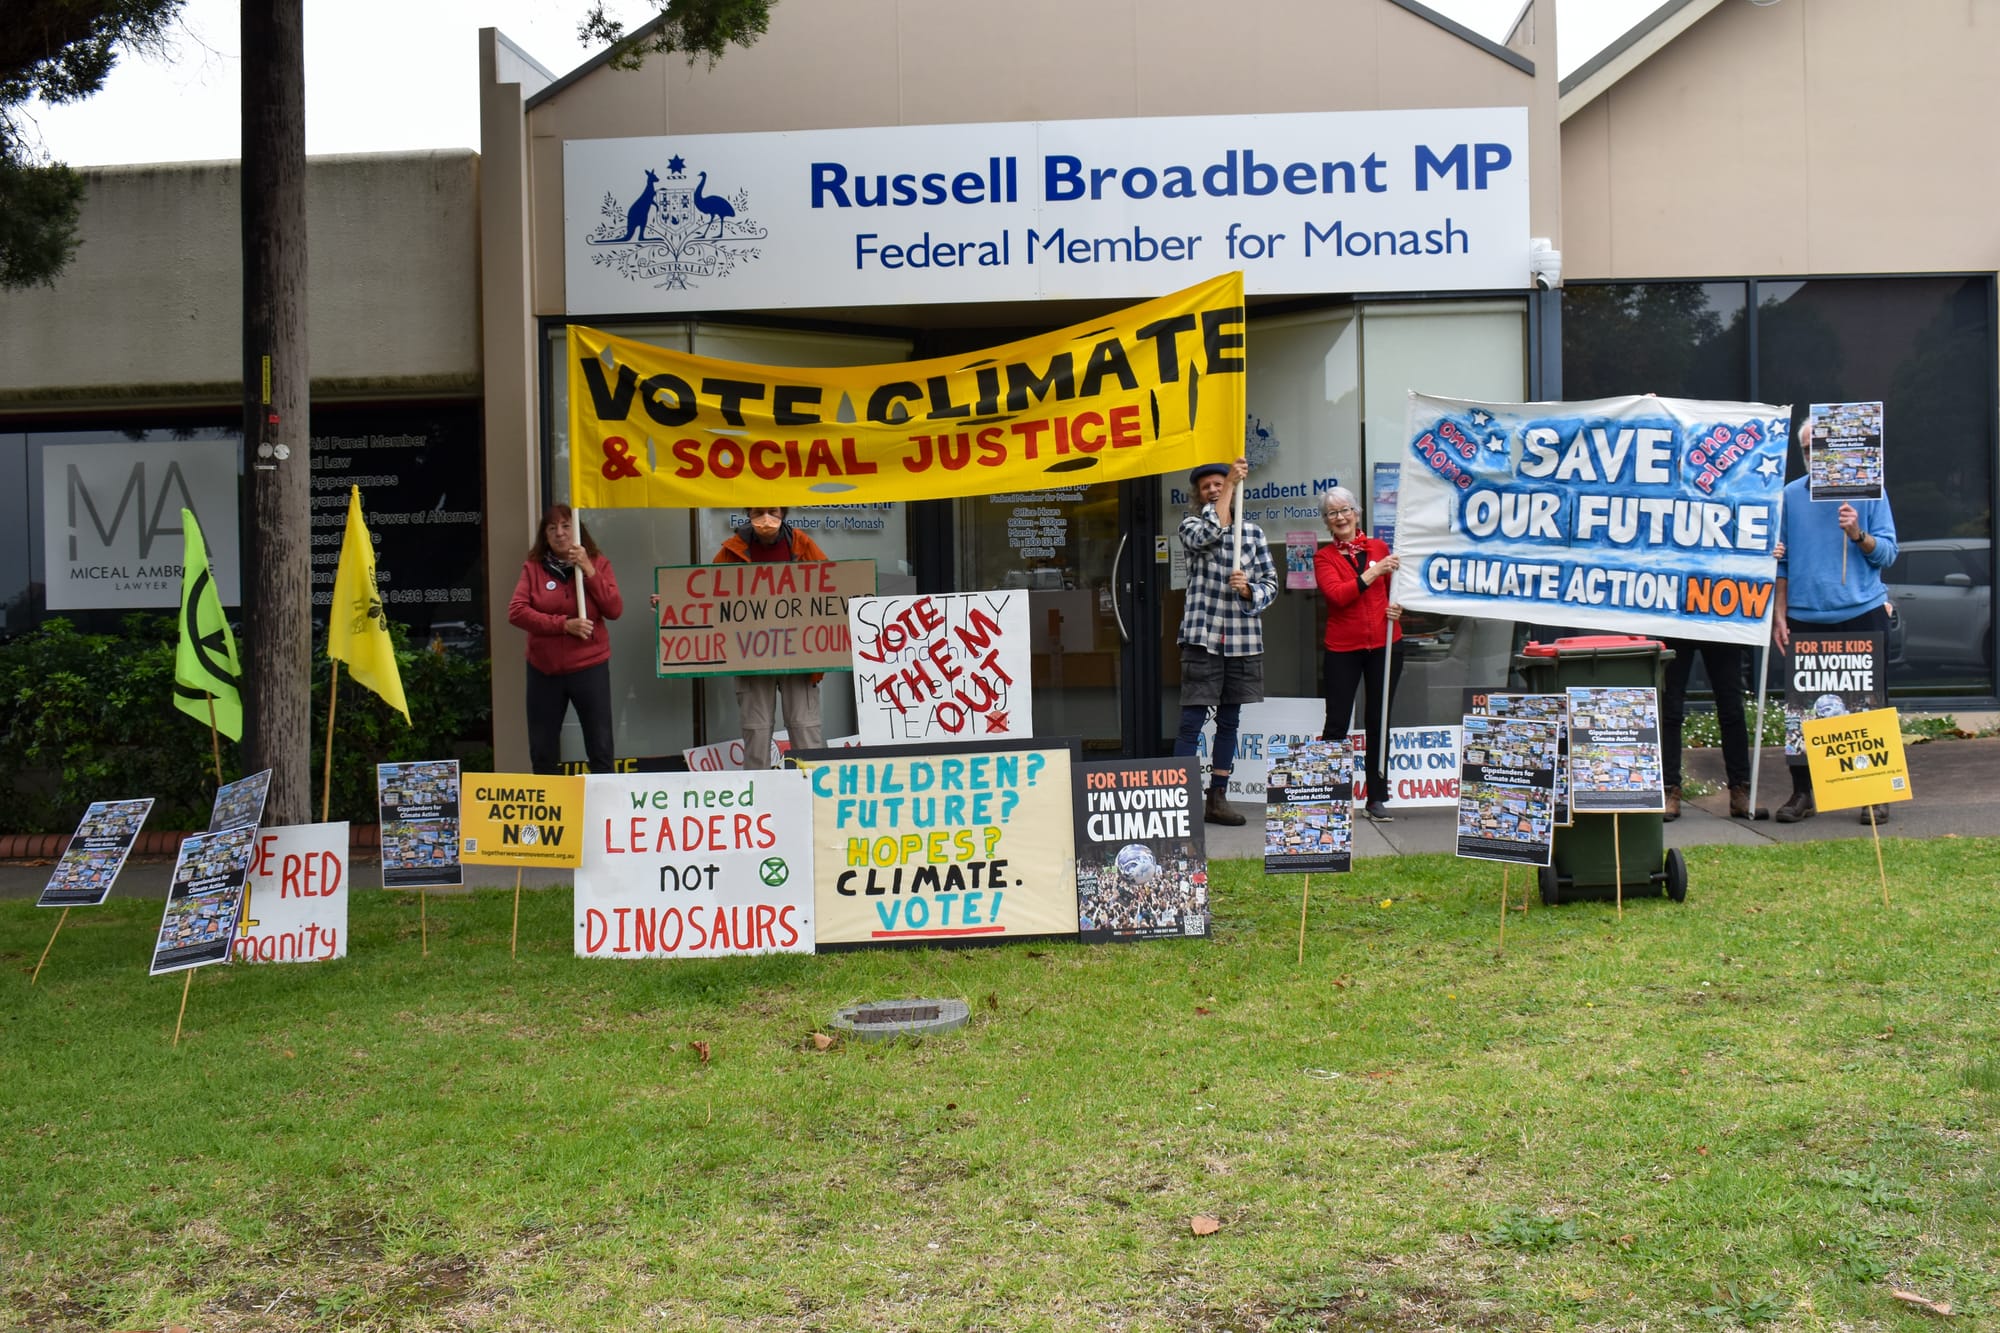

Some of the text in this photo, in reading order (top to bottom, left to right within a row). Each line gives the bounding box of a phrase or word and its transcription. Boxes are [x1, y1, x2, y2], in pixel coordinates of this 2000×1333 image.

[810, 143, 1512, 209] Russell Broadbent MP
[855, 217, 1469, 270] Federal Member for Monash
[645, 262, 709, 276] AUSTRALIA
[580, 306, 1246, 427] VOTE CLIMATE
[331, 435, 368, 449] Panel
[370, 434, 427, 448] Member
[602, 404, 1144, 482] & SOCIAL JUSTICE
[1440, 422, 1477, 459] one
[1519, 423, 1673, 483] SAVE
[1689, 425, 1731, 465] one
[324, 456, 352, 469] Law
[1416, 433, 1473, 489] home
[1243, 482, 1307, 501] oadbent
[370, 510, 482, 525] Power of Attorney
[826, 514, 841, 528] for
[844, 514, 884, 529] Monash
[1037, 507, 1061, 516] Hours
[1266, 506, 1281, 520] for
[1284, 506, 1320, 519] Monas
[1465, 490, 1769, 550] OUR FUTURE
[70, 566, 129, 580] MICEAL
[115, 581, 168, 591] LAWYER
[687, 562, 838, 598] CLIMATE
[1428, 556, 1773, 619] CLIMATE ACTION NOW
[661, 603, 713, 626] ACT
[720, 600, 767, 622] NOW
[775, 597, 803, 618] OR
[859, 596, 945, 663] VOTE
[662, 632, 726, 662] YOUR
[737, 627, 797, 658] VOTE
[1795, 640, 1873, 653] FOR THE KIDS
[874, 608, 1003, 714] THEM
[1795, 654, 1874, 670] I'M VOTING
[937, 648, 1013, 733] OUT
[1793, 671, 1874, 692] CLIMATE
[1393, 731, 1453, 749] WHERE
[1812, 728, 1869, 746] CLIMATE
[1825, 737, 1885, 757] ACTION
[812, 753, 1046, 799] CHILDREN?
[1389, 753, 1456, 770] YOU ON
[1481, 766, 1524, 777] Gippslanders
[1087, 772, 1118, 789] FOR
[1121, 771, 1150, 788] THE
[1152, 768, 1188, 785] KIDS
[1398, 778, 1460, 800] CHANG
[1484, 774, 1531, 785] Climate Action
[475, 788, 546, 803] CLIMATE
[631, 780, 755, 810] we need
[836, 790, 1020, 829] FUTURE?
[1087, 788, 1189, 812] I'M VOTING
[488, 804, 562, 821] ACTION
[1086, 809, 1191, 842] CLIMATE
[605, 813, 776, 854] LEADERS
[847, 827, 1002, 868] HOPES?
[281, 850, 342, 899] RED
[660, 863, 720, 892] not
[837, 859, 1024, 897] CLIMATE.
[876, 892, 1004, 931] VOTE!
[585, 904, 799, 954] DINOSAURS
